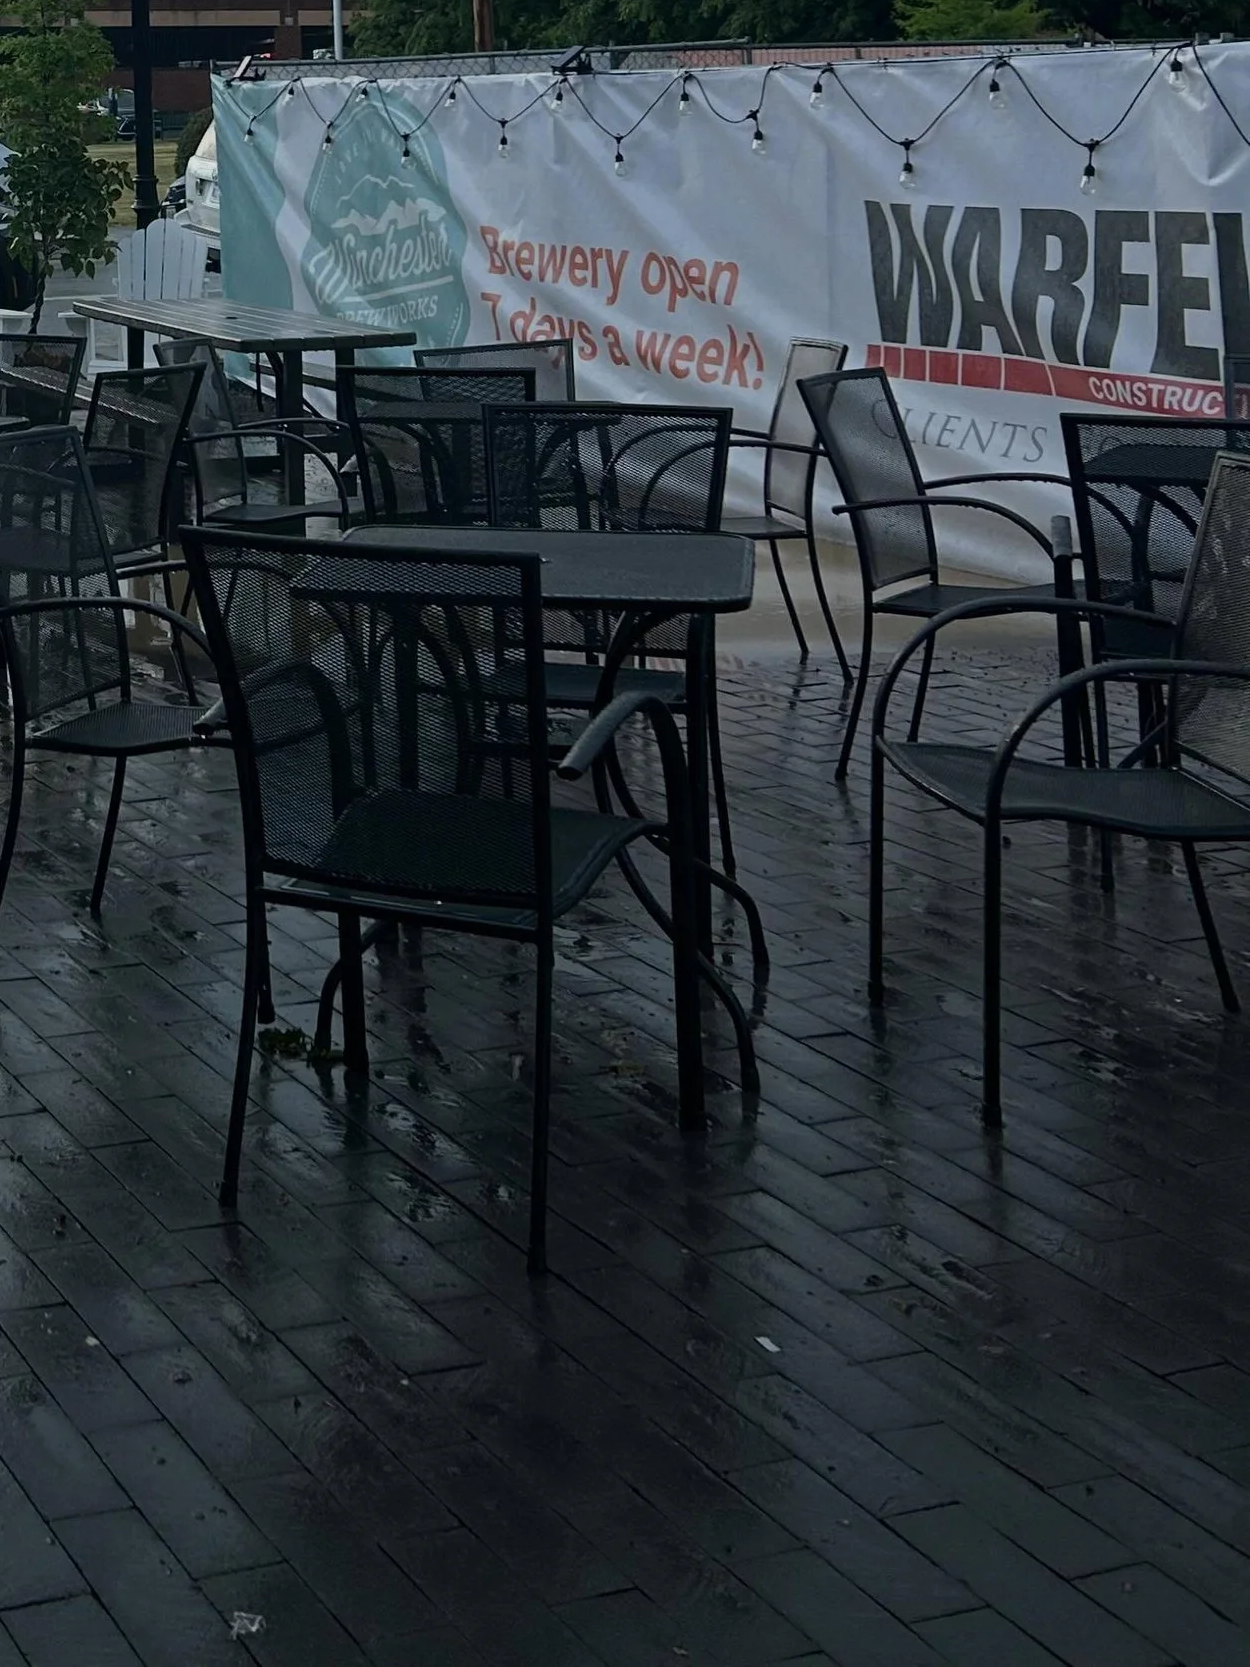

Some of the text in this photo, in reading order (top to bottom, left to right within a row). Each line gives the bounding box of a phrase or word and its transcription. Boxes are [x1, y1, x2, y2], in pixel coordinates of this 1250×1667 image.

[308, 210, 452, 304] Winchester
[479, 225, 740, 313] Brewery open
[480, 292, 765, 390] 7 days a week!
[871, 398, 1048, 463] CLIENTS
[1088, 376, 1248, 420] CONSTRUC
